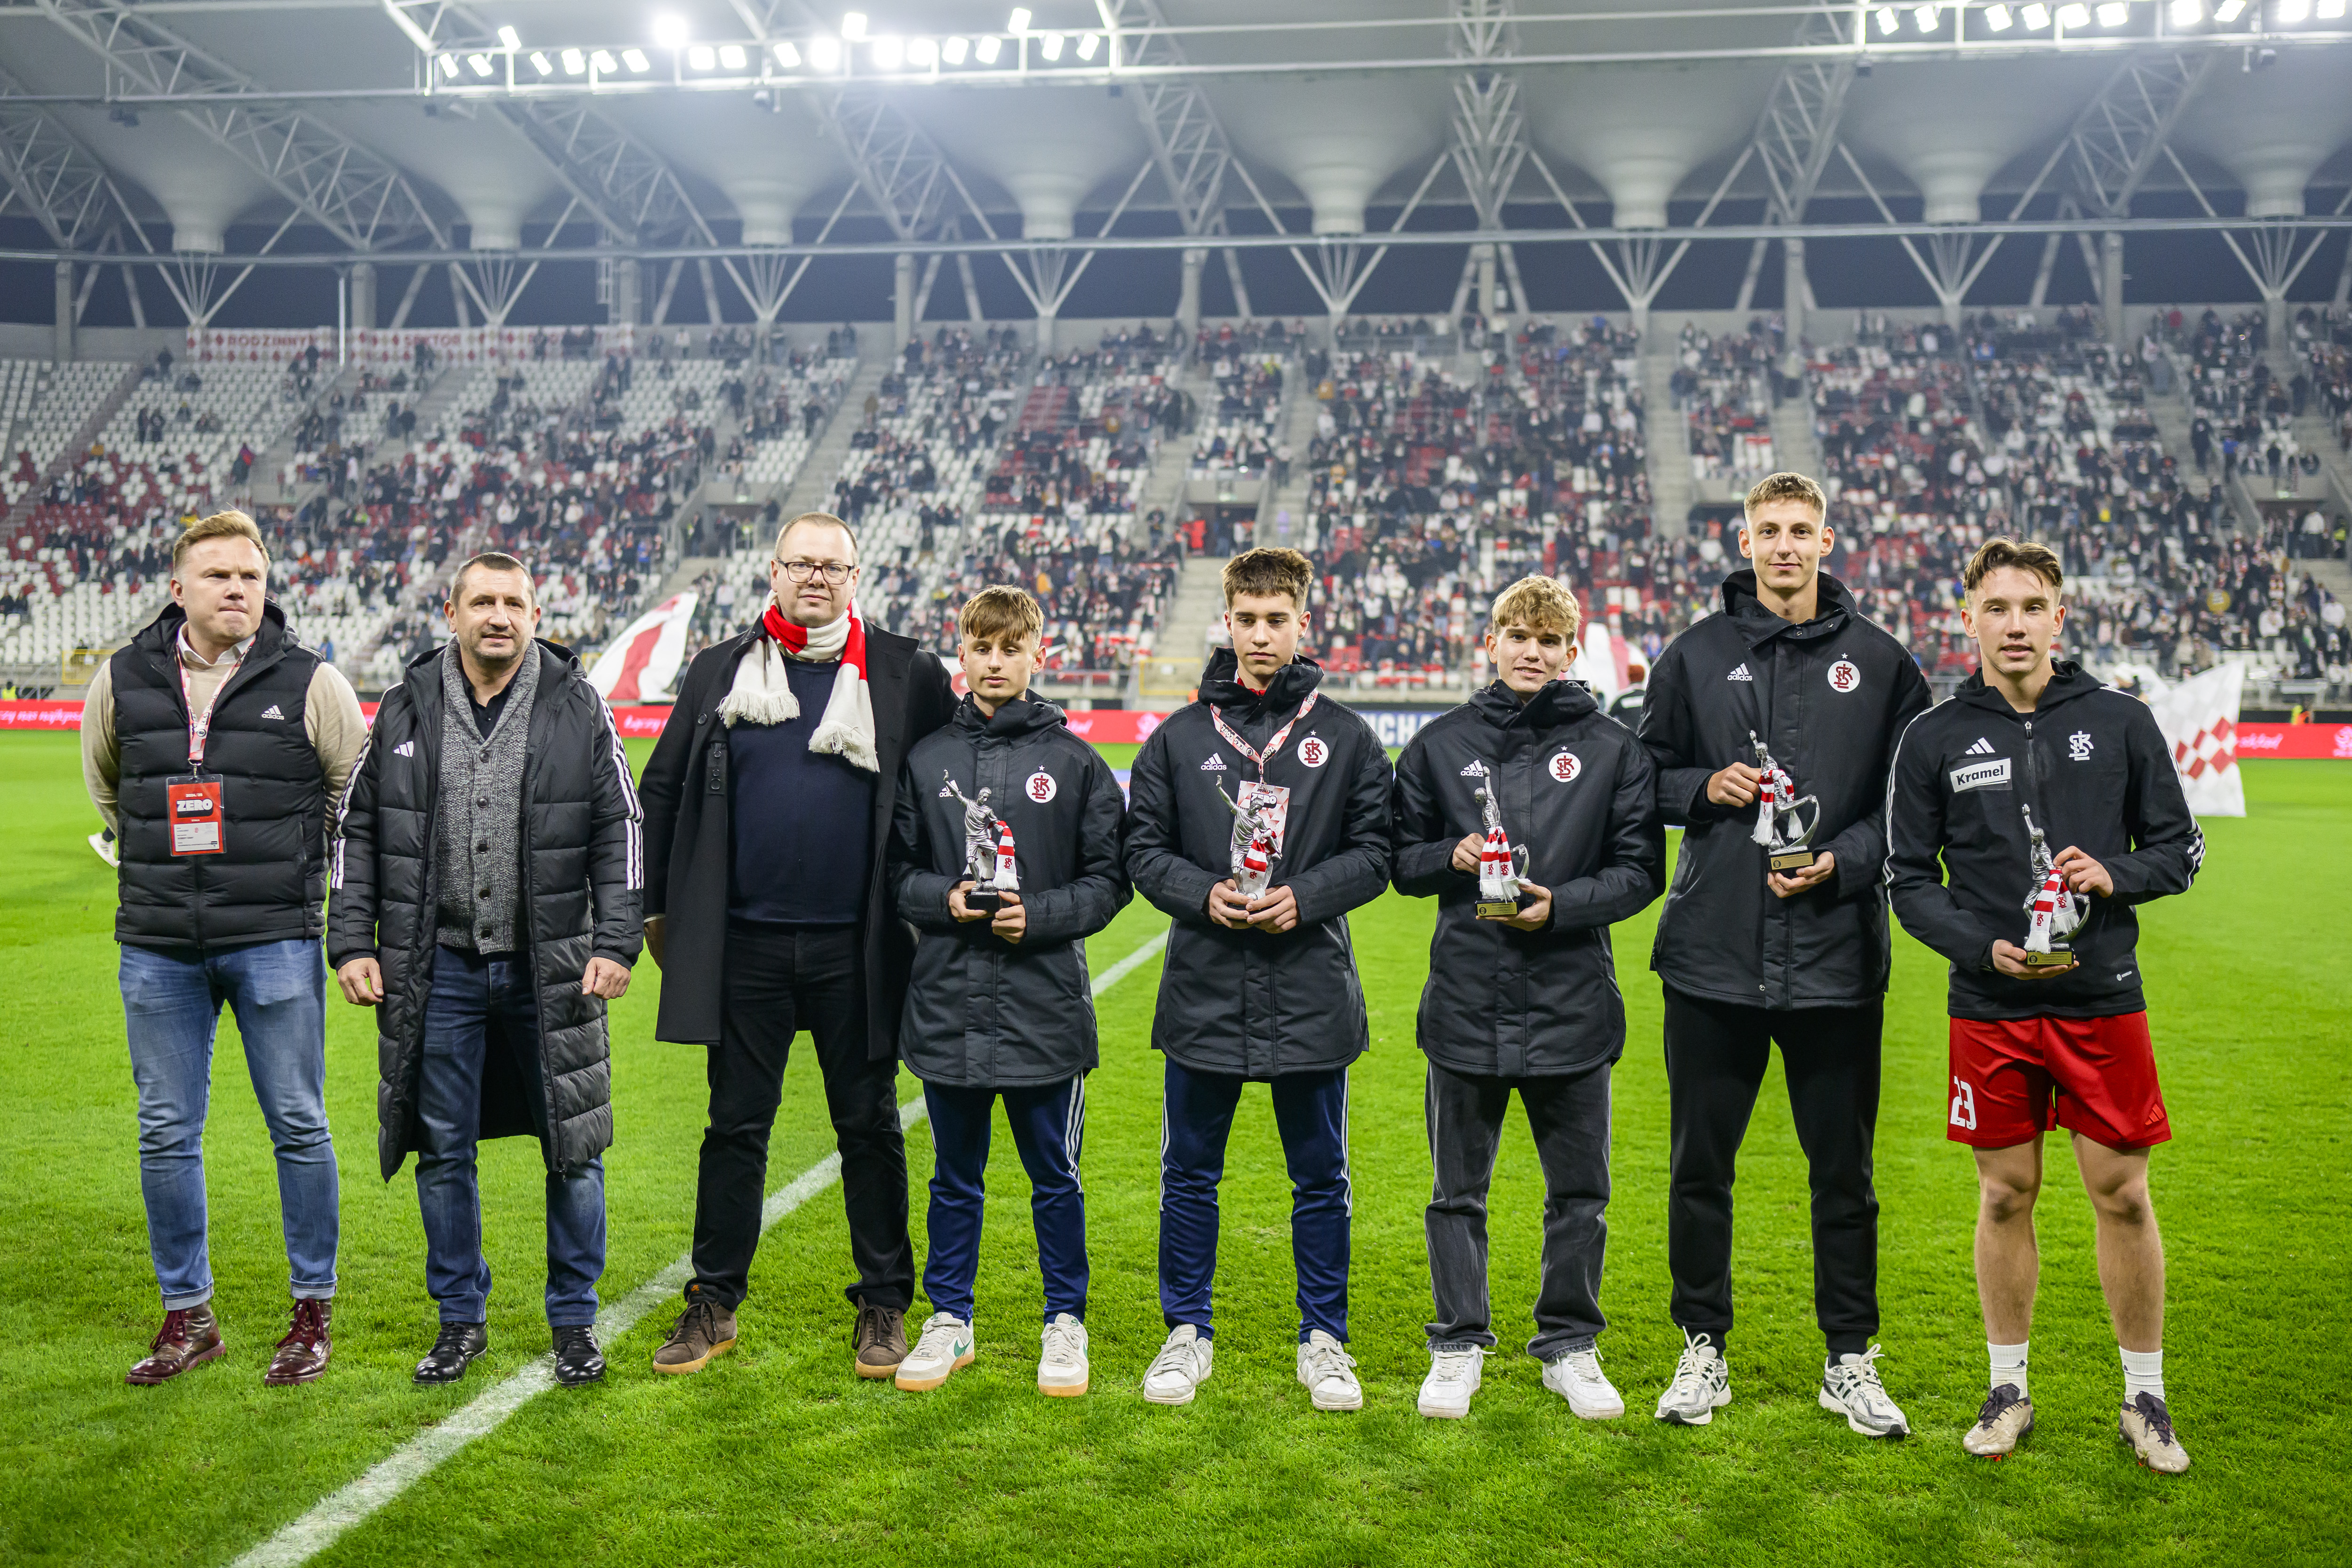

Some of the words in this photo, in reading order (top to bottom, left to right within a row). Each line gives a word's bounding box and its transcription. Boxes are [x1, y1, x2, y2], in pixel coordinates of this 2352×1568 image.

[228, 334, 306, 347] RODZINNY
[1956, 764, 2004, 786] Kramel
[176, 798, 214, 812] ZERO
[1950, 1075, 1977, 1130] 23
